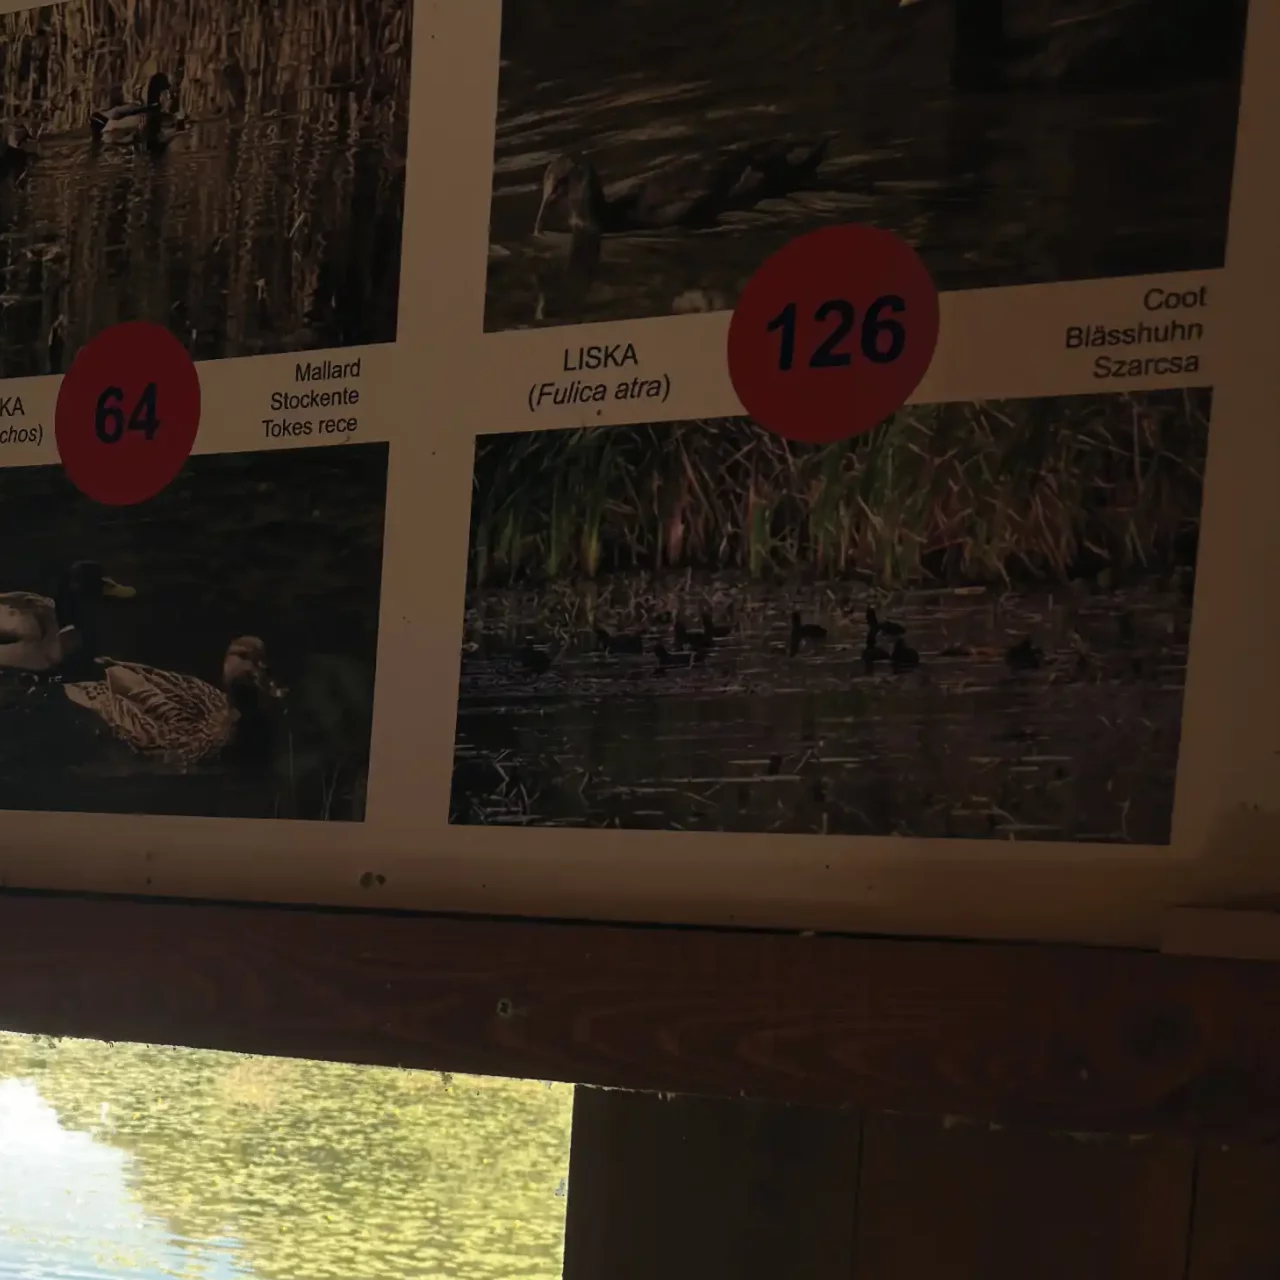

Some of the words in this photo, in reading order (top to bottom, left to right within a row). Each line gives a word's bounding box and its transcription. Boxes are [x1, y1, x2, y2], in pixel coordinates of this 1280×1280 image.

[1143, 285, 1208, 311] Coot
[767, 294, 907, 371] 126
[1064, 318, 1205, 350] Blässhuhn
[295, 358, 361, 383] Mallard
[563, 343, 639, 372] LISKA
[1092, 351, 1200, 379] Szarcsa
[270, 387, 360, 411] Stockente
[528, 378, 608, 412] (Fulica
[614, 373, 671, 404] atra)
[95, 381, 161, 444] 64
[262, 417, 313, 438] Tokes
[318, 418, 358, 435] rece
